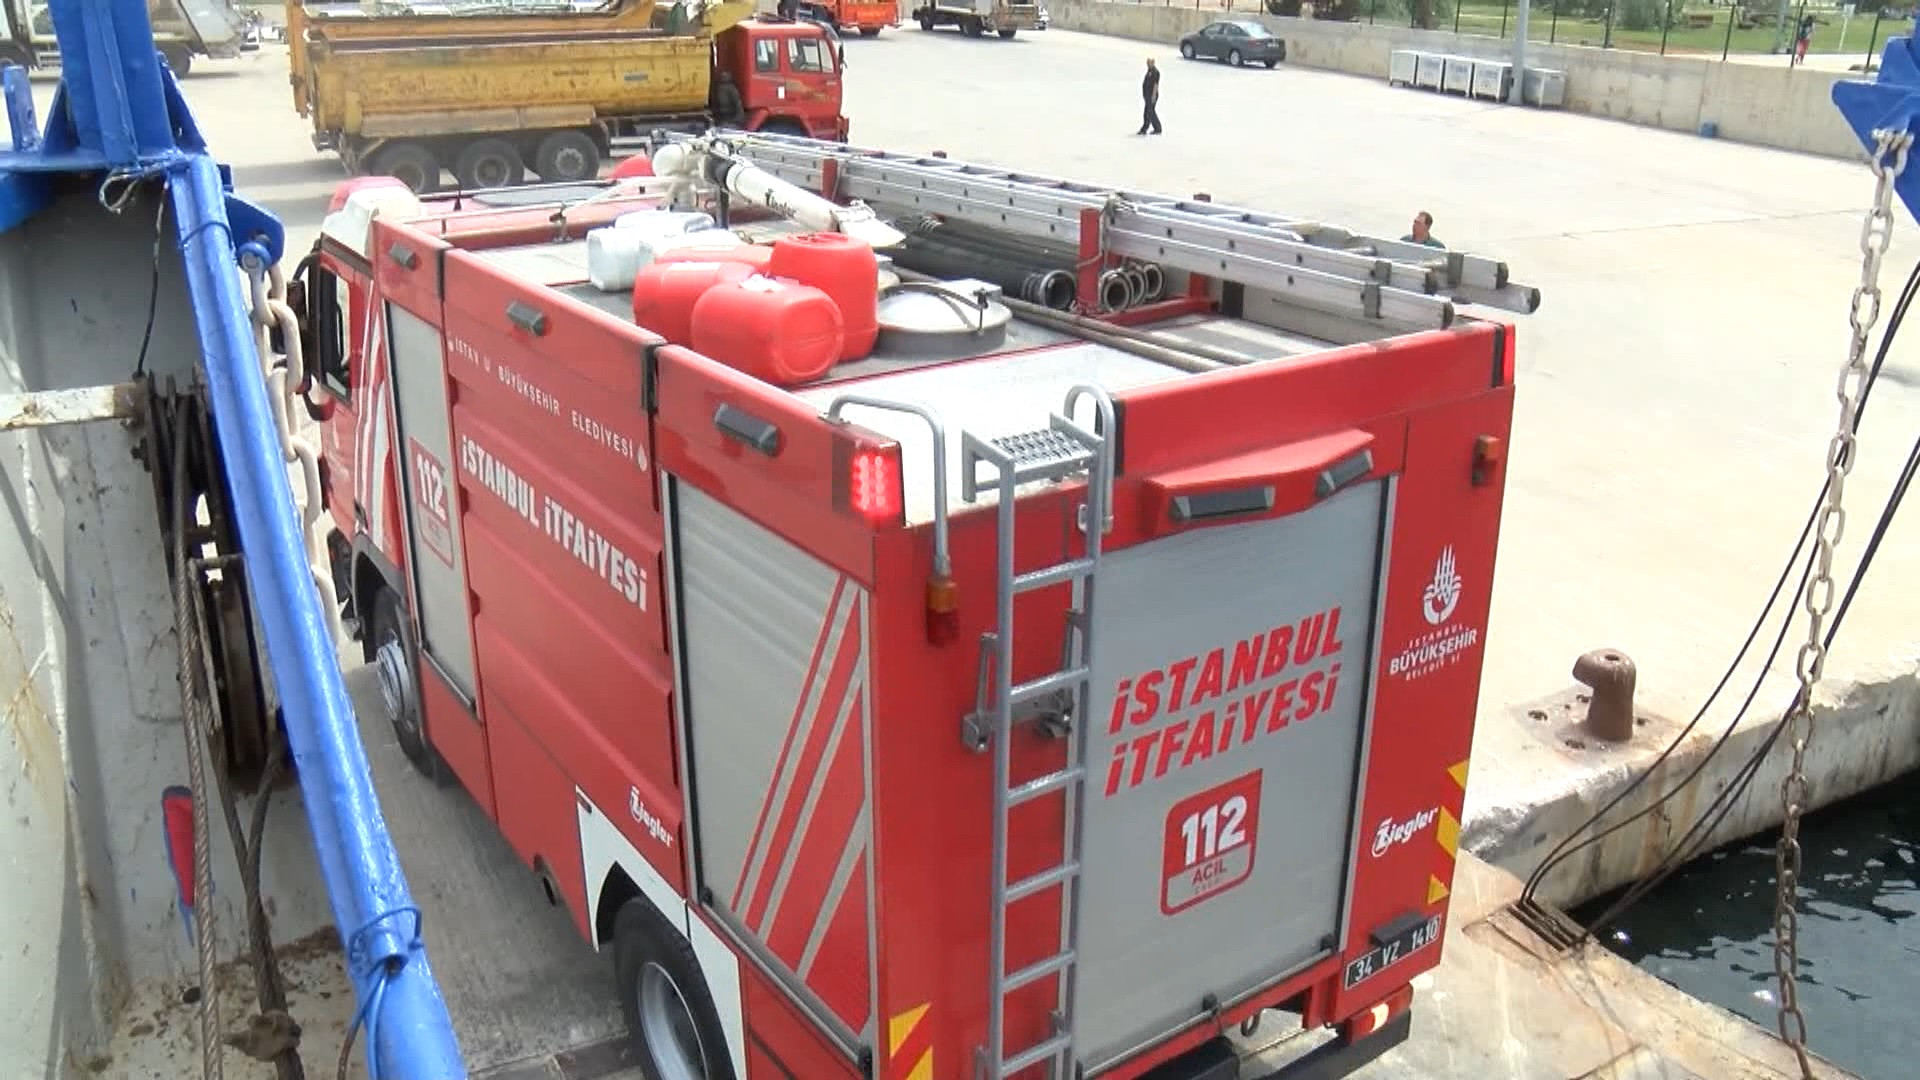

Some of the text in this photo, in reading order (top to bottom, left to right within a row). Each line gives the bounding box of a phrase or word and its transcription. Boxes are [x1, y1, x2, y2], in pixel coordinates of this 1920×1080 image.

[571, 410, 634, 459] ELEDİYESİ
[417, 453, 446, 521] 112
[462, 435, 648, 611] İSTANBUL İTFAİYESİ
[1108, 606, 1343, 735] İSTANBUL
[1389, 627, 1478, 676] BÜYÜKŞEHİR
[1105, 663, 1342, 797] İTFAİYESİ
[1181, 795, 1248, 867] 112
[1371, 806, 1439, 858] Ziegler
[1354, 916, 1440, 982] 34 VZ 1410
